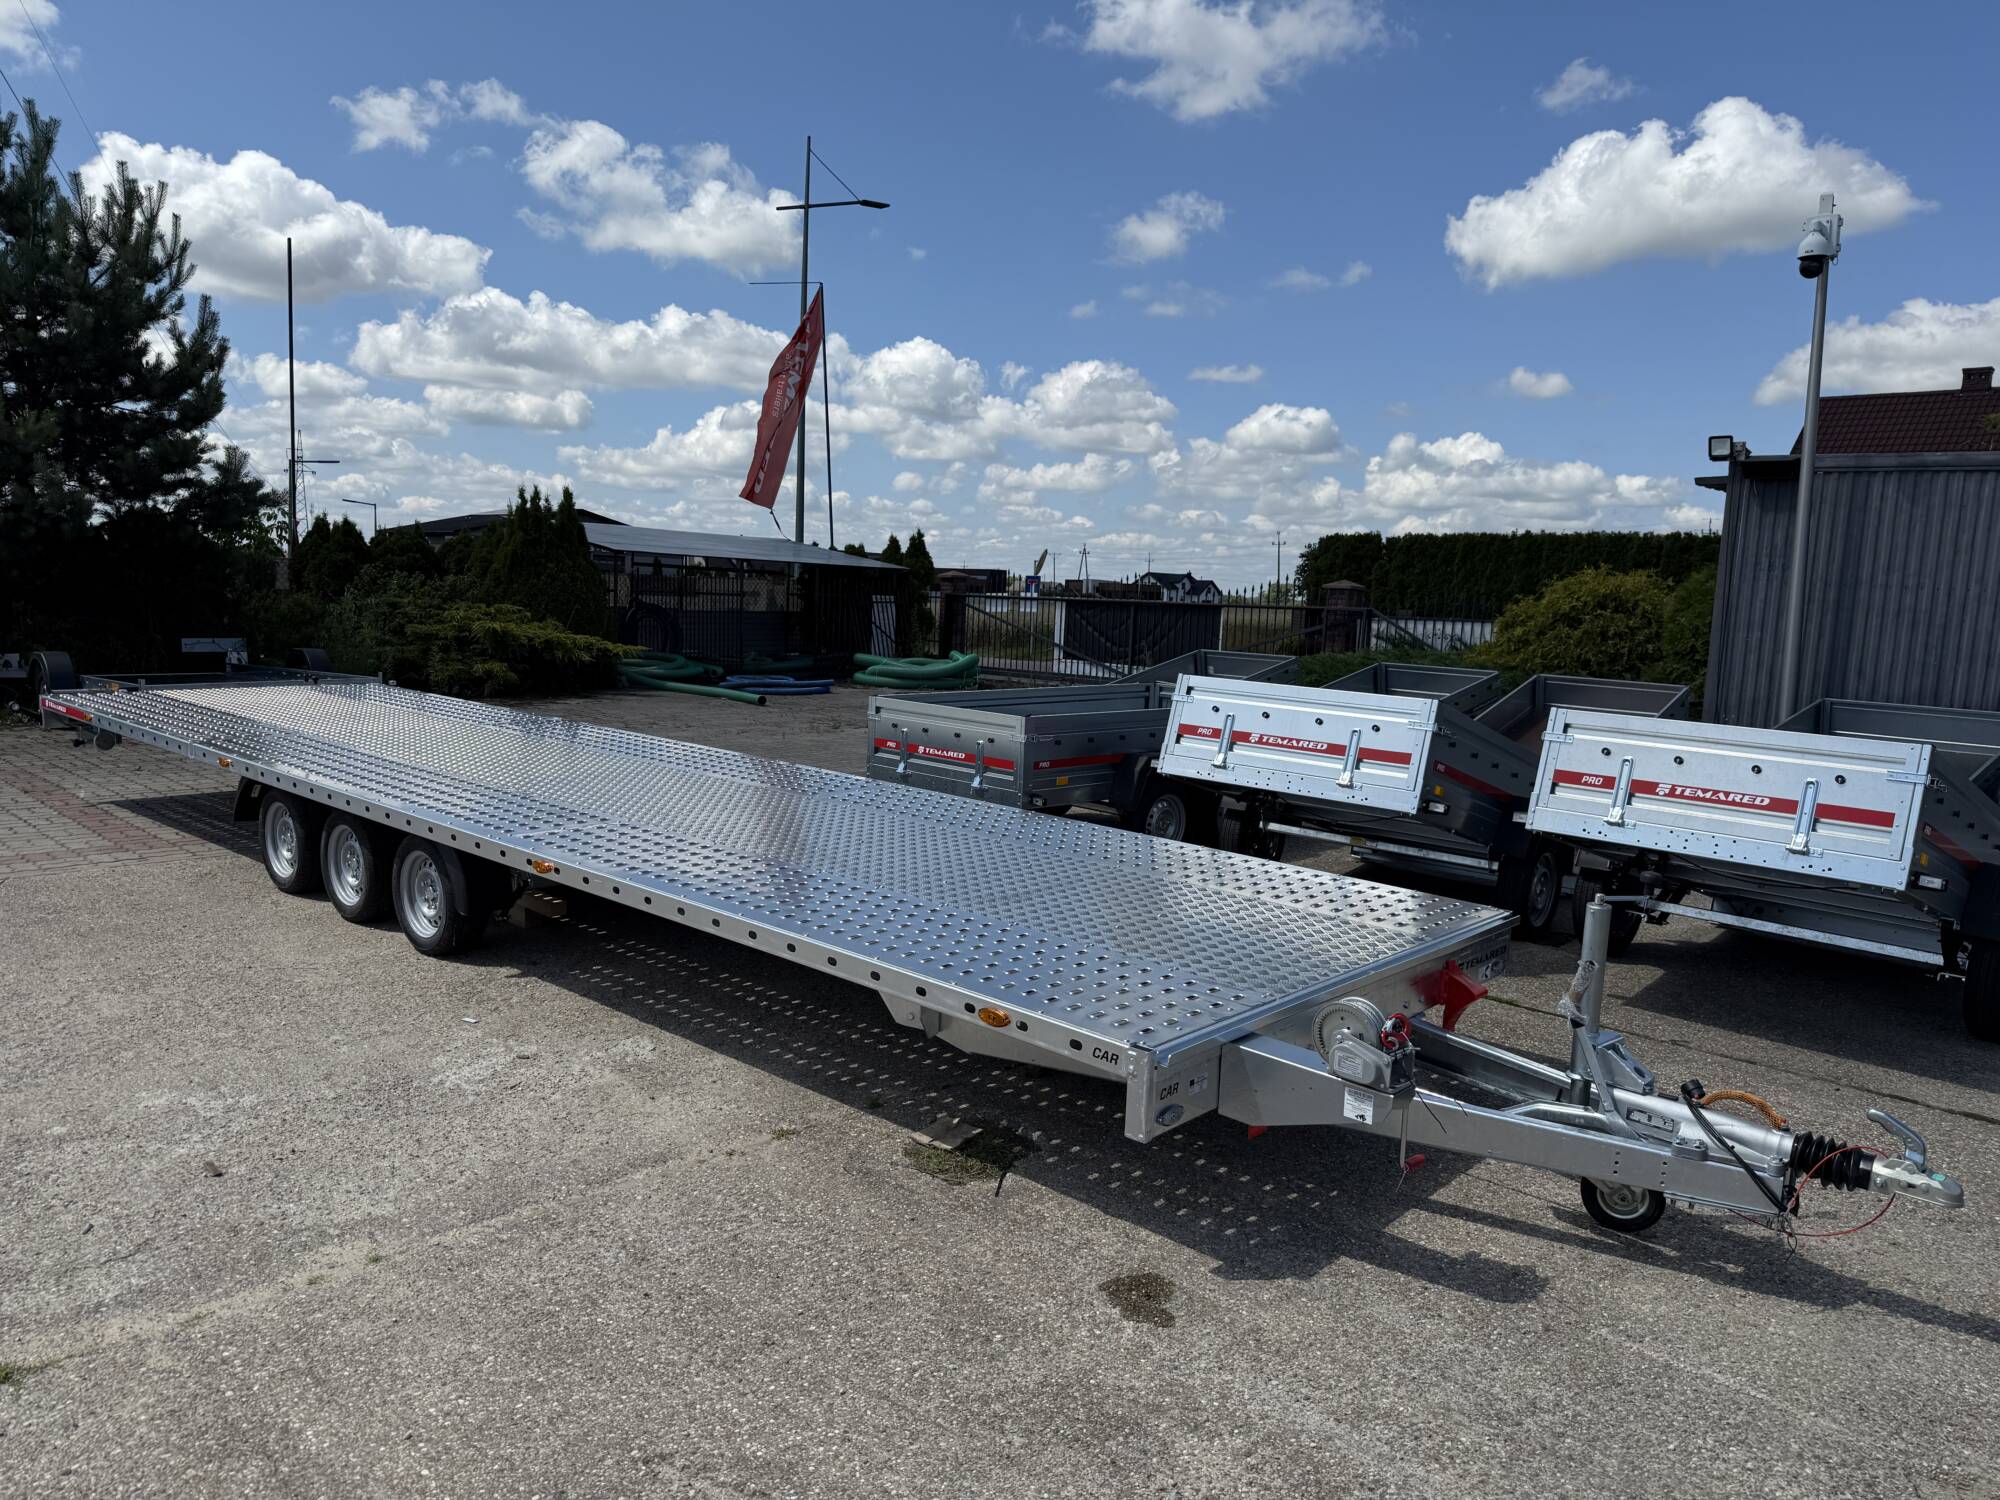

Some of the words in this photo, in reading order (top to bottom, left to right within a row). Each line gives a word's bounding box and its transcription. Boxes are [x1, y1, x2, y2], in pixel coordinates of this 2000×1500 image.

[771, 380, 787, 418] trailers
[1197, 727, 1213, 736] PRO
[1260, 735, 1328, 751] TEMARED
[925, 747, 966, 759] TEMARED
[1581, 775, 1603, 785] PRO
[1674, 786, 1770, 806] TEMARED
[1092, 1046, 1120, 1066] CAR
[1159, 1081, 1180, 1101] CAR
